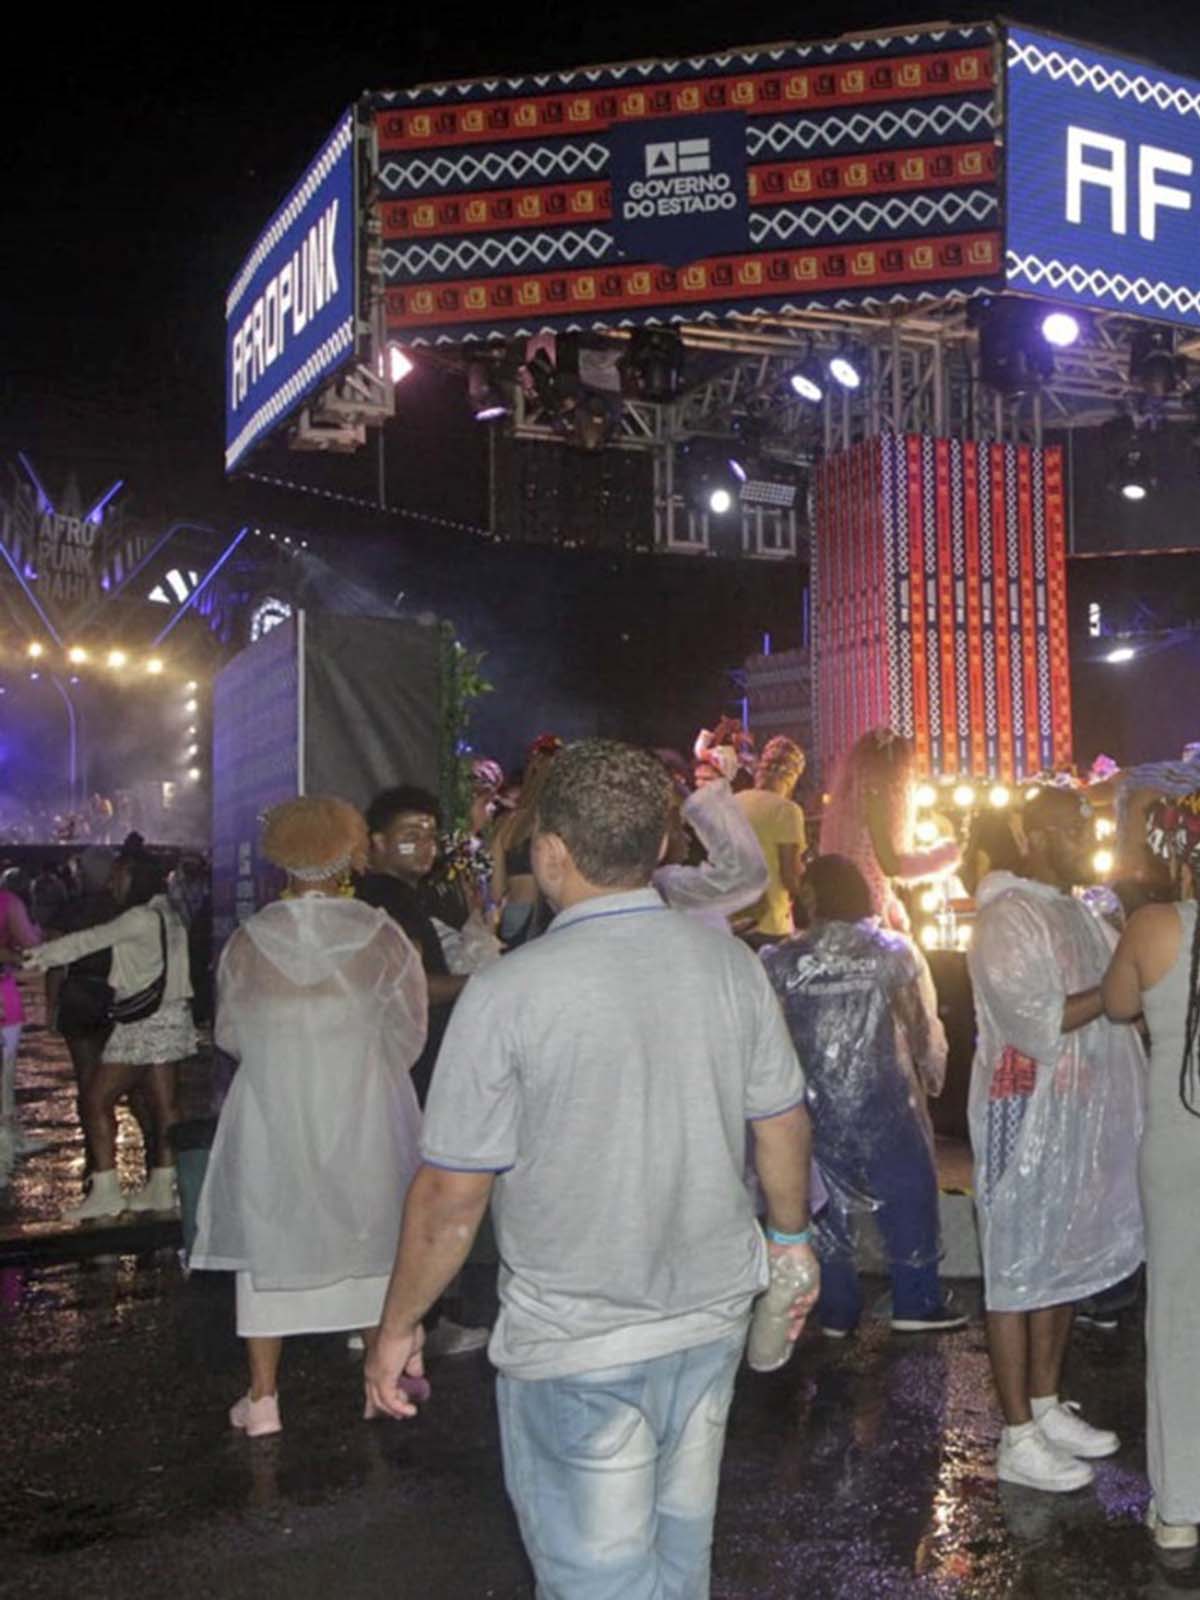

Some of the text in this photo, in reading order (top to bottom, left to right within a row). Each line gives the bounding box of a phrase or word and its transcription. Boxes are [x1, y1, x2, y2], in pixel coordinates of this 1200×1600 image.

[628, 173, 730, 199] GOVERNO
[623, 192, 737, 219] DO ESTADO
[231, 198, 339, 412] AFROPUNK
[39, 510, 97, 546] AFRO
